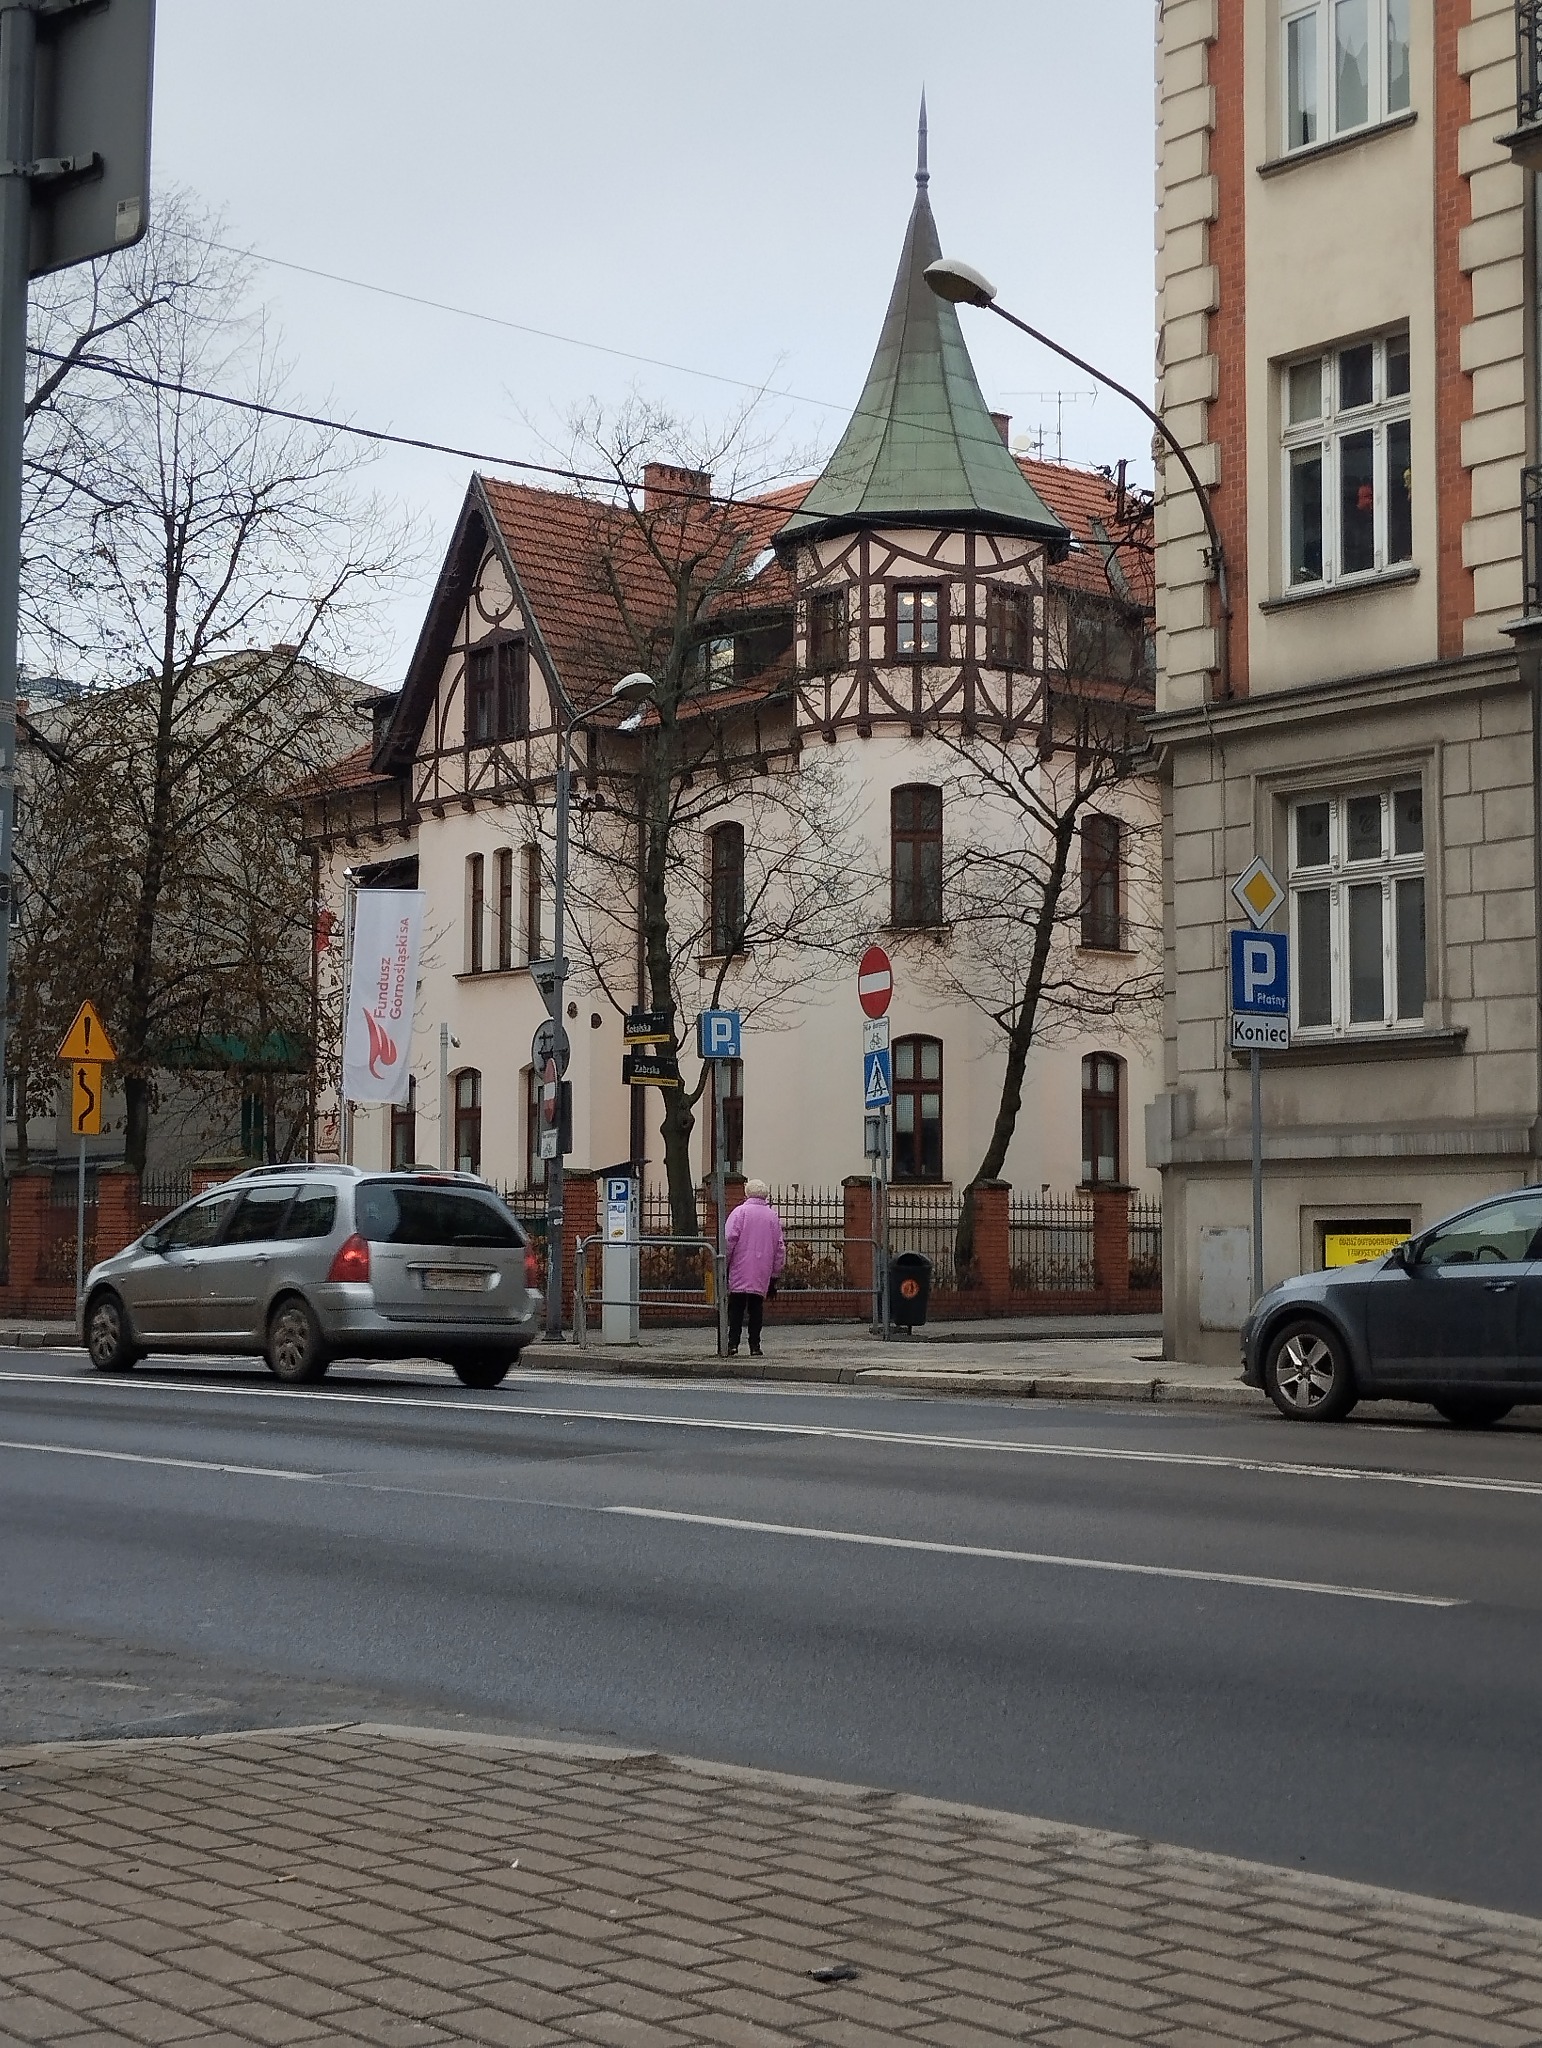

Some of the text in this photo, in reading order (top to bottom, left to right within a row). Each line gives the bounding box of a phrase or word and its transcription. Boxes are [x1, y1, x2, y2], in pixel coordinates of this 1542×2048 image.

[390, 917, 409, 1020] Górnośląski SA
[1244, 940, 1276, 1002] P
[374, 957, 391, 1018] Fundusz
[1257, 992, 1287, 1008] Płatny
[711, 1017, 732, 1051] P
[1235, 1021, 1287, 1042] Koniec
[611, 1181, 626, 1199] P
